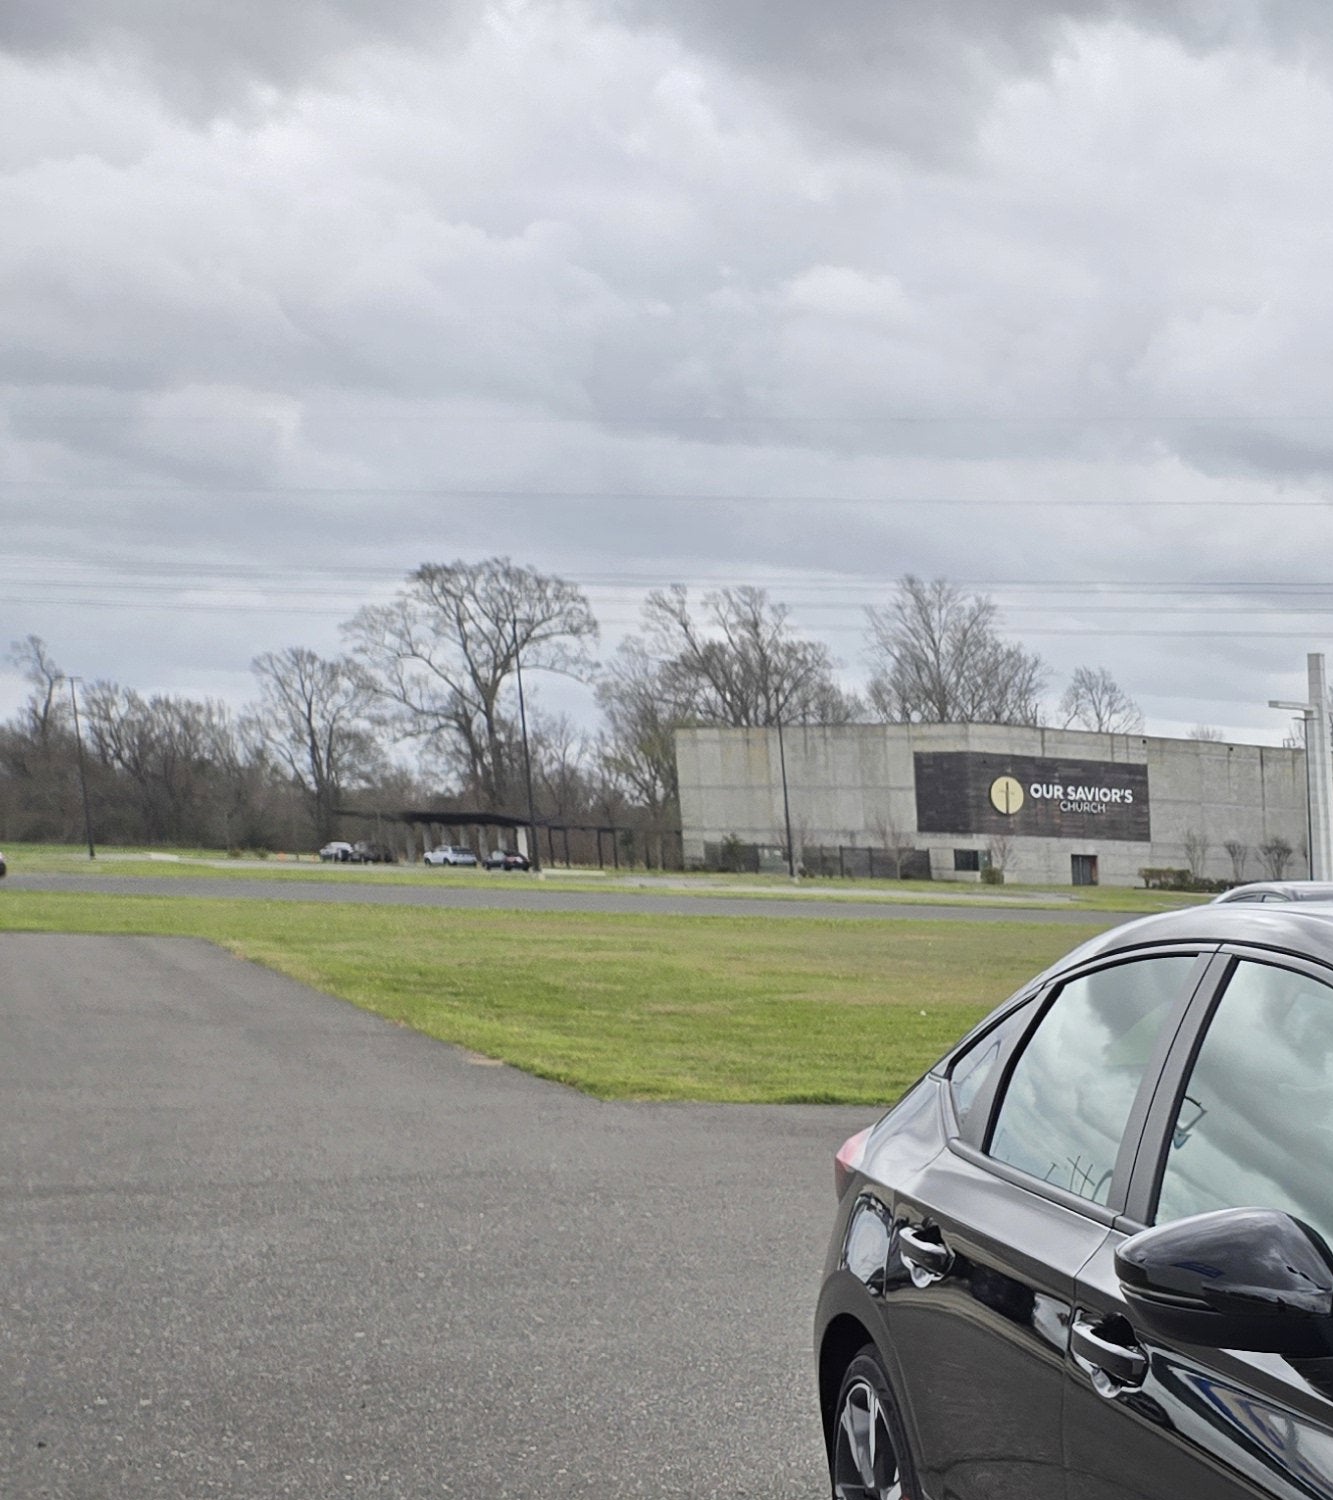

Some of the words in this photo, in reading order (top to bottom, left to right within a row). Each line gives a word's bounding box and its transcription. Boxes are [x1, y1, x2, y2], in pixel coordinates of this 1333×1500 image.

[1029, 783, 1064, 800] OUR
[1067, 785, 1134, 804] SAVIOR'S
[1059, 800, 1107, 814] CHURCH
